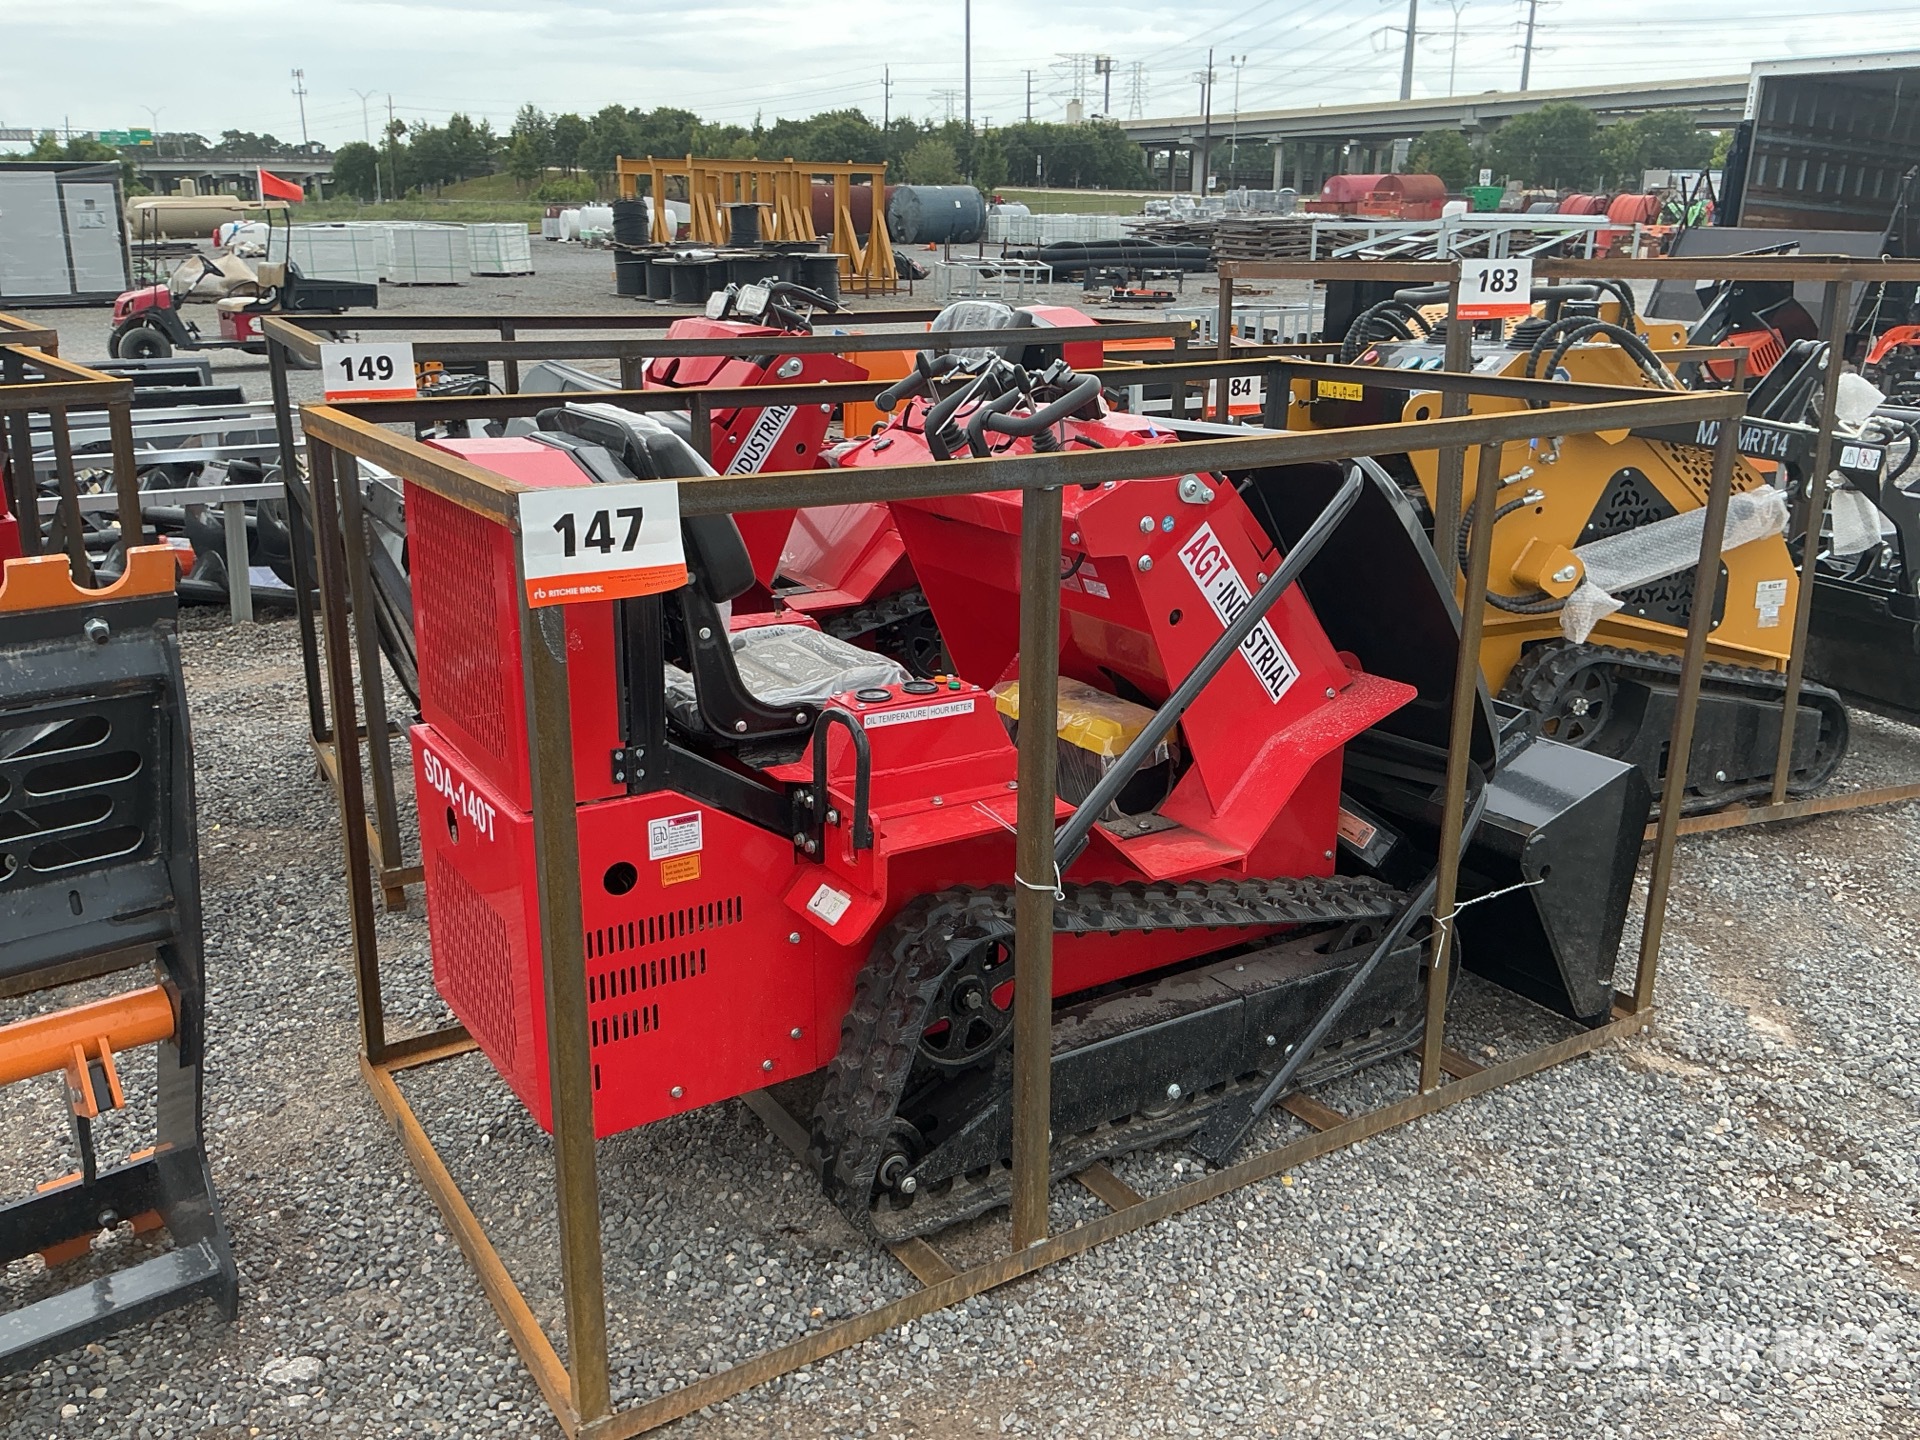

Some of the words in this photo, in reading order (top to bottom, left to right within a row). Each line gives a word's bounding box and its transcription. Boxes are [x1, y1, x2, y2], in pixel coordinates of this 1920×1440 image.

[1478, 268, 1519, 293] 183
[340, 355, 394, 382] 149
[1230, 378, 1252, 397] 84
[730, 405, 791, 475] DUSTRIAL
[1695, 420, 1791, 457] MMRT14
[552, 506, 644, 558] 147
[534, 587, 547, 600] rb
[548, 588, 579, 598] RITCHIE
[1184, 531, 1231, 588] AGT
[1216, 580, 1290, 698] INSTRIAL
[865, 717, 877, 726] OIL
[878, 709, 927, 724] TEMPERATURE
[930, 707, 950, 716] HOUR
[950, 702, 973, 713] METER
[423, 748, 496, 842] SDA-140T
